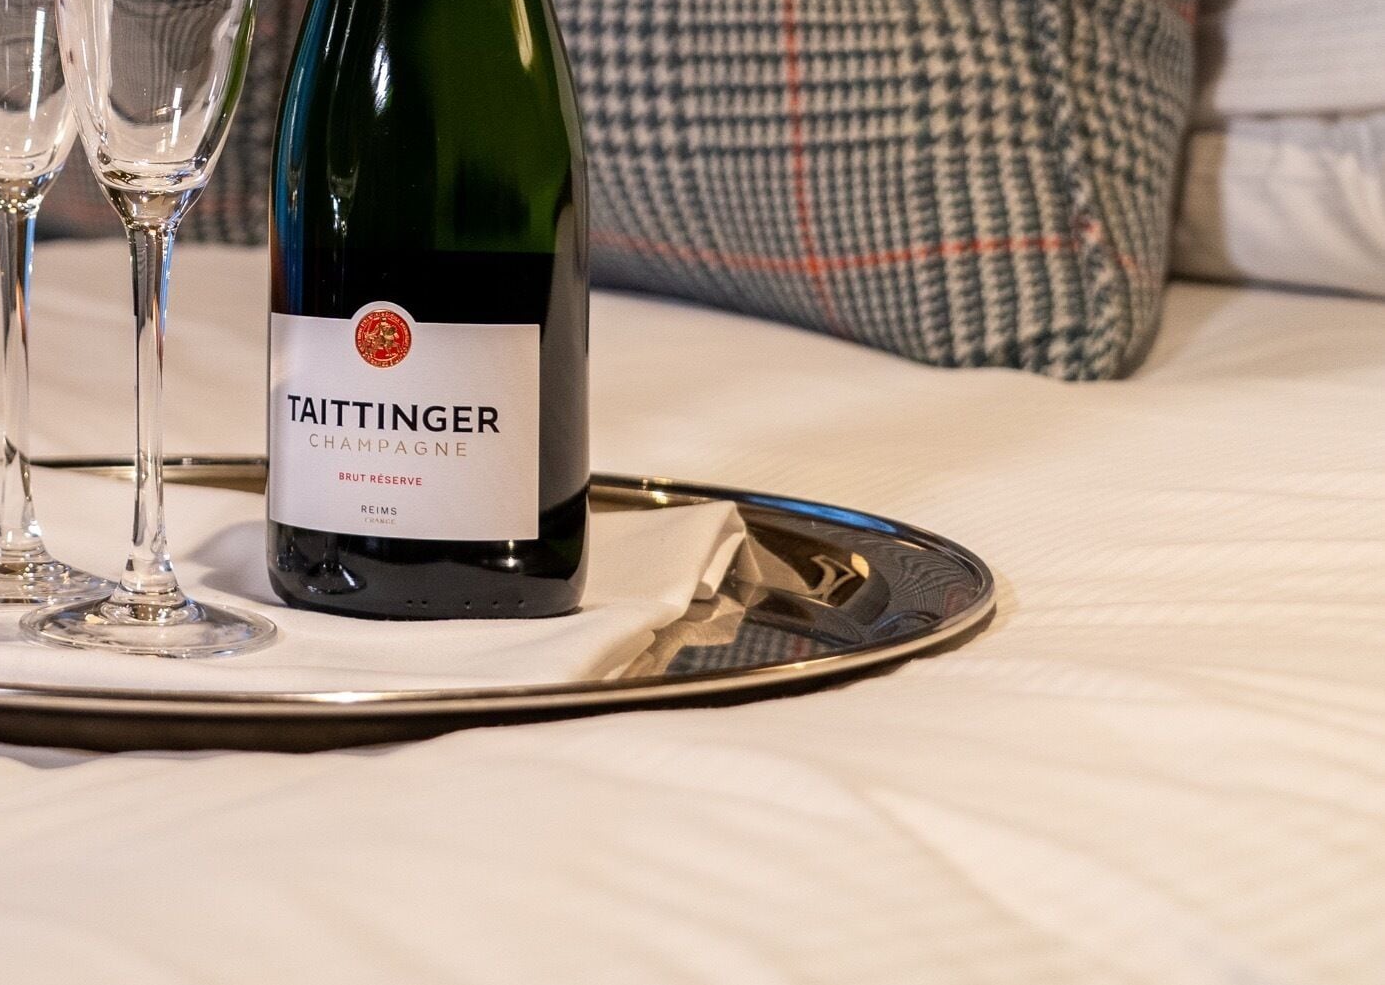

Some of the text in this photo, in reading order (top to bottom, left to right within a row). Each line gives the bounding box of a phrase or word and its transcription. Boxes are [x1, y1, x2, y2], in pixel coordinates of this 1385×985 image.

[287, 394, 500, 434] TAITTINGER
[308, 433, 468, 457] CHAMPAGNE
[338, 471, 423, 486] BRUT RÉSERVE
[360, 504, 398, 516] REIMS
